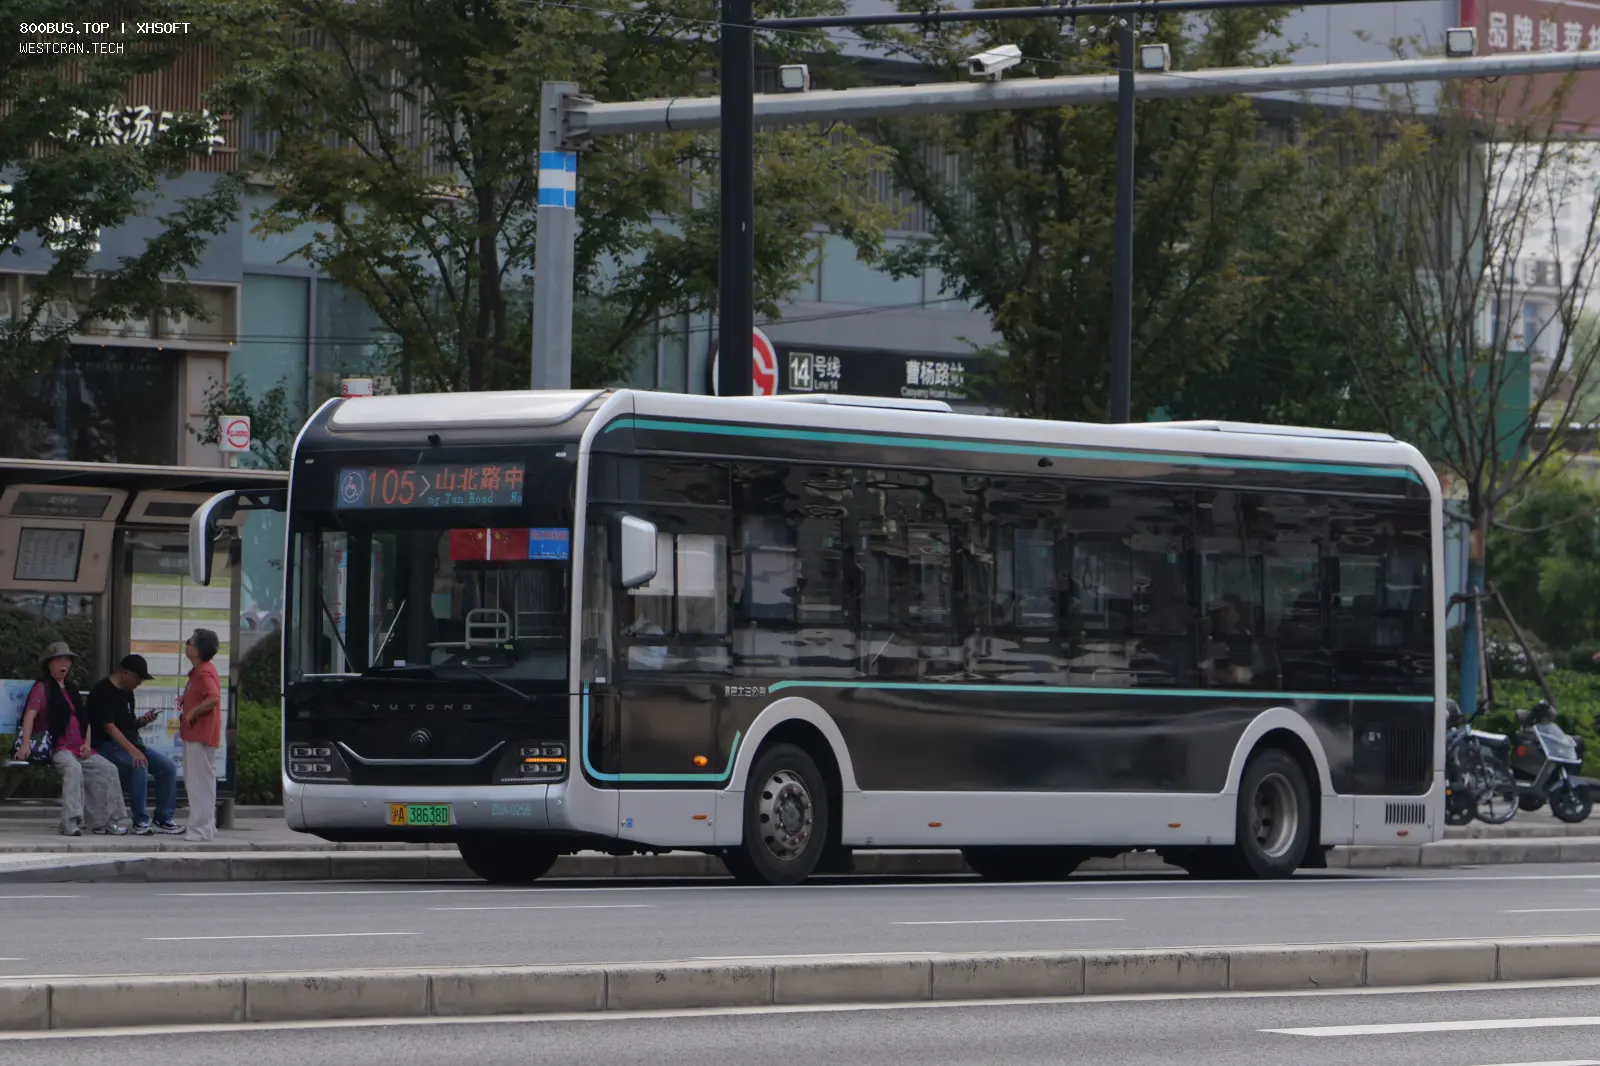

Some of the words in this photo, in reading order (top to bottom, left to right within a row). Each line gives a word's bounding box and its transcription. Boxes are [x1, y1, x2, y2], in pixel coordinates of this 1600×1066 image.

[790, 356, 810, 386] 14
[814, 355, 842, 379] 号线
[368, 469, 415, 504] 105
